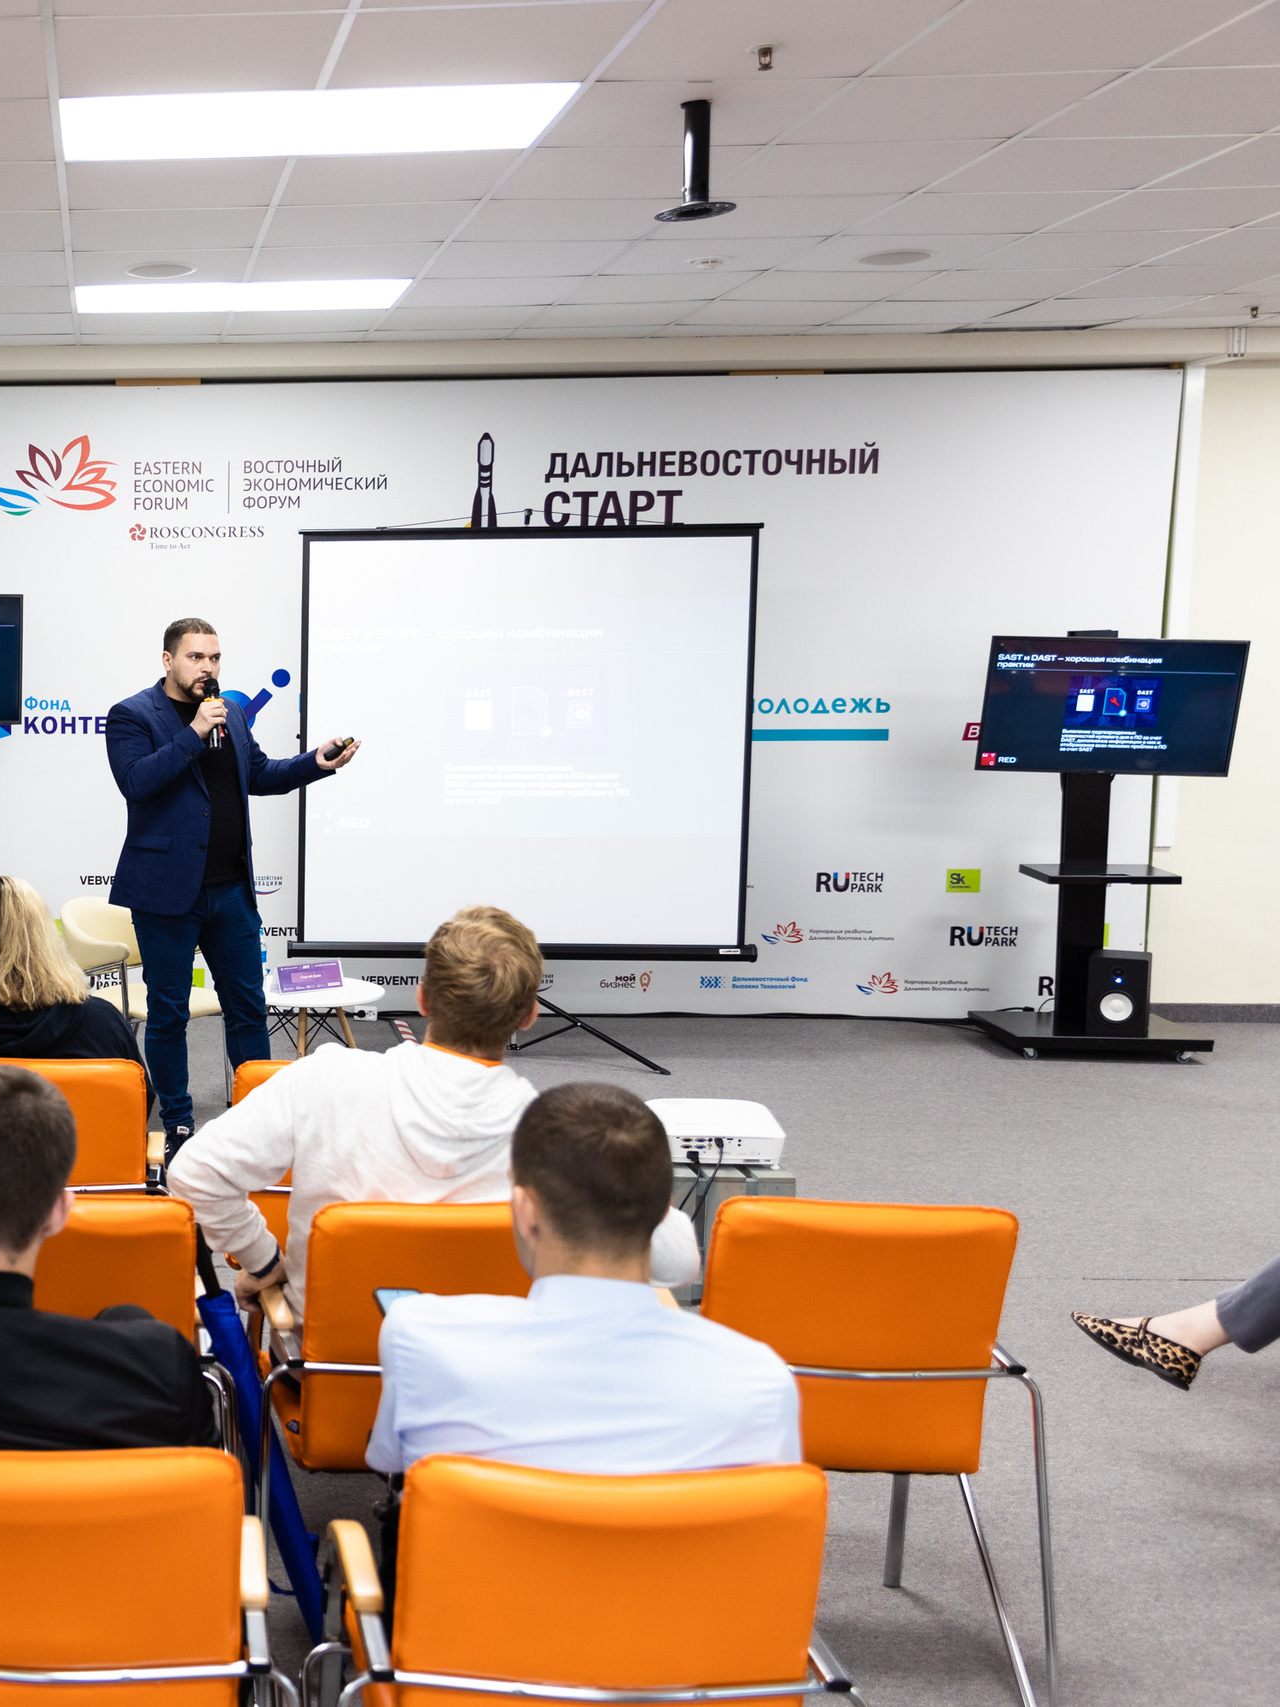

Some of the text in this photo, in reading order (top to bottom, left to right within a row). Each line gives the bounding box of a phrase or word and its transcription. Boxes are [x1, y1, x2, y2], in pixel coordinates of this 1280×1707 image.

[134, 461, 202, 476] EASTERN
[244, 456, 342, 474] ВОСТОЧНЫЙ
[544, 442, 879, 483] ДАЛЬНЕВОСТОЧНЫЙ
[134, 479, 214, 493] ECONOMIC
[243, 474, 388, 492] ЭКОНОМИЧЕСКИЙ
[134, 497, 189, 511] FORUM
[243, 495, 301, 510] ФОРУМ
[543, 490, 683, 527] СТАРТ
[149, 526, 264, 539] ROSCONGRESS
[150, 542, 190, 550] Time to Act
[1031, 654, 1057, 662] DAST
[1065, 655, 1104, 664] хорошая
[1106, 656, 1163, 665] комбинация
[24, 696, 71, 712] Фонд
[752, 697, 891, 714] олодежь
[998, 756, 1017, 764] RED
[816, 872, 850, 892] RU
[852, 872, 884, 882] TECH
[950, 873, 966, 884] Sk
[851, 883, 883, 892] PARK
[950, 926, 984, 947] RU
[986, 926, 1018, 936] TECH
[984, 937, 1017, 947] PARK
[600, 979, 636, 988] бизнес
[615, 974, 636, 982] мой
